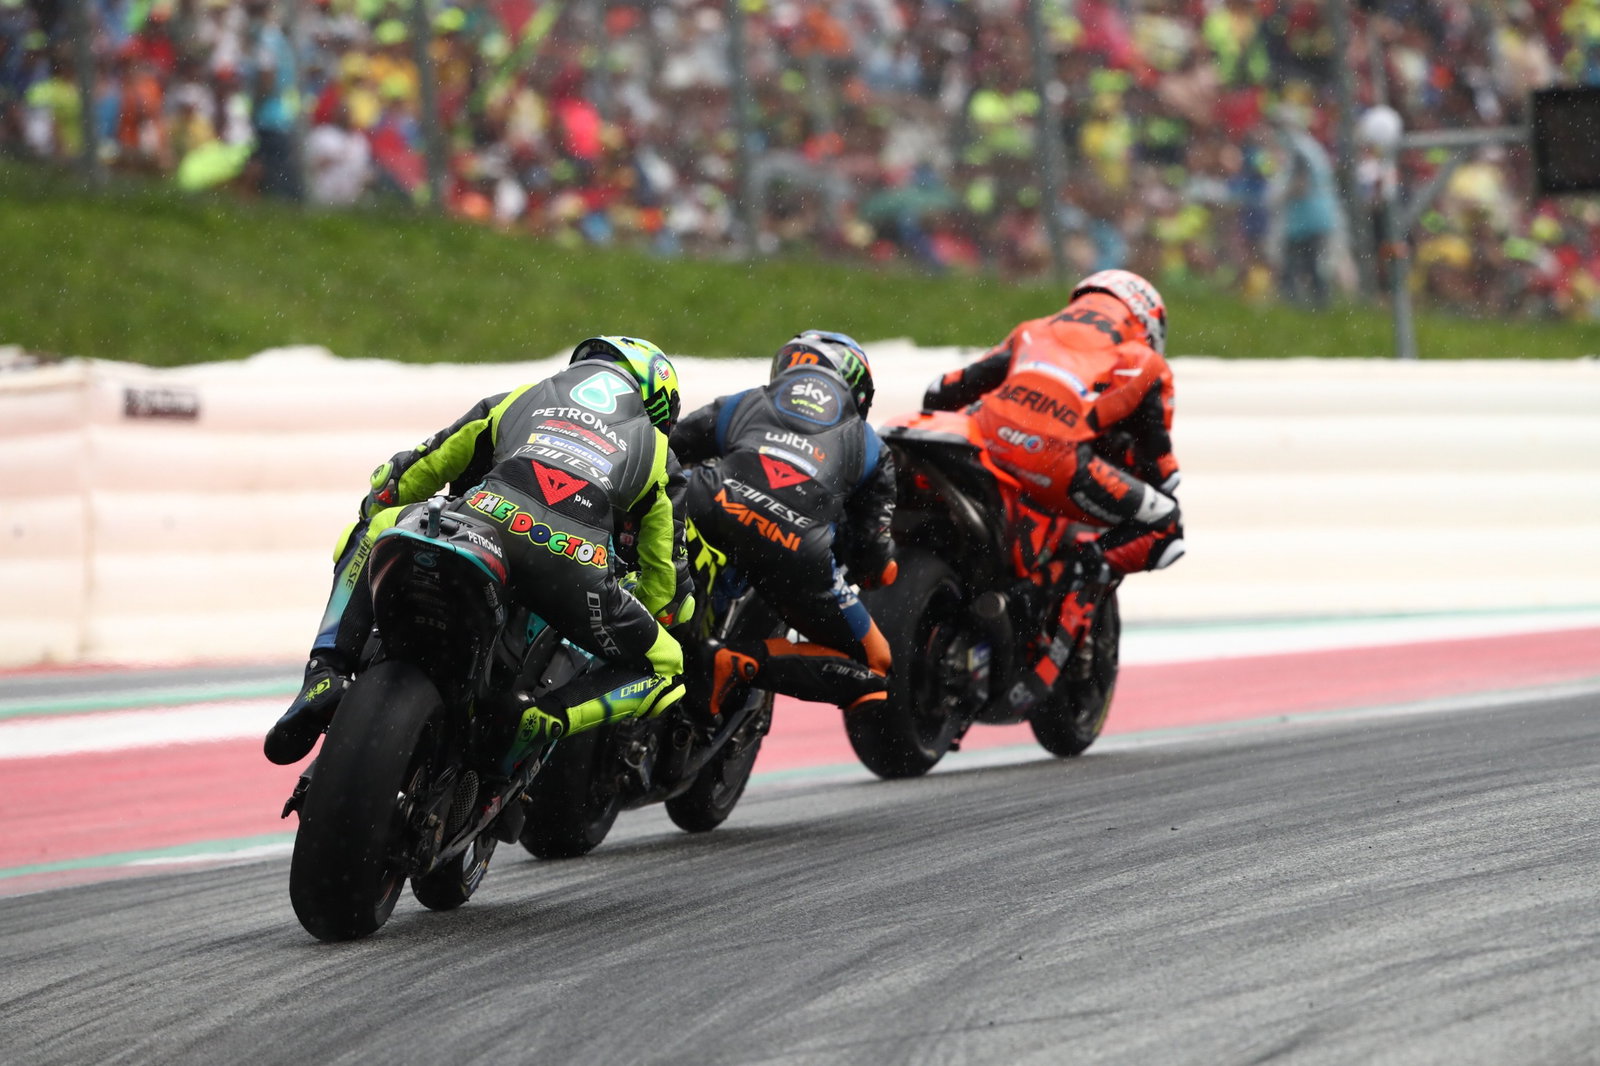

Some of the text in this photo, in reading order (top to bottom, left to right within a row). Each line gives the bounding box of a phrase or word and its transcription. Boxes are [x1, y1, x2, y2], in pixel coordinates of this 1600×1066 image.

[791, 382, 832, 405] sky
[532, 407, 628, 451] PETRONAS
[536, 425, 579, 438] RACING
[581, 436, 611, 455] TEAM
[997, 426, 1026, 445] elf
[511, 445, 614, 490] DAINESE
[553, 440, 606, 466] MICHELIN
[722, 478, 813, 529] DAINESE
[466, 491, 519, 523] THE
[508, 511, 608, 569] DOCTOR
[714, 487, 801, 552] MARINI
[466, 530, 503, 559] PETRONAS
[620, 677, 661, 698] DAINE
